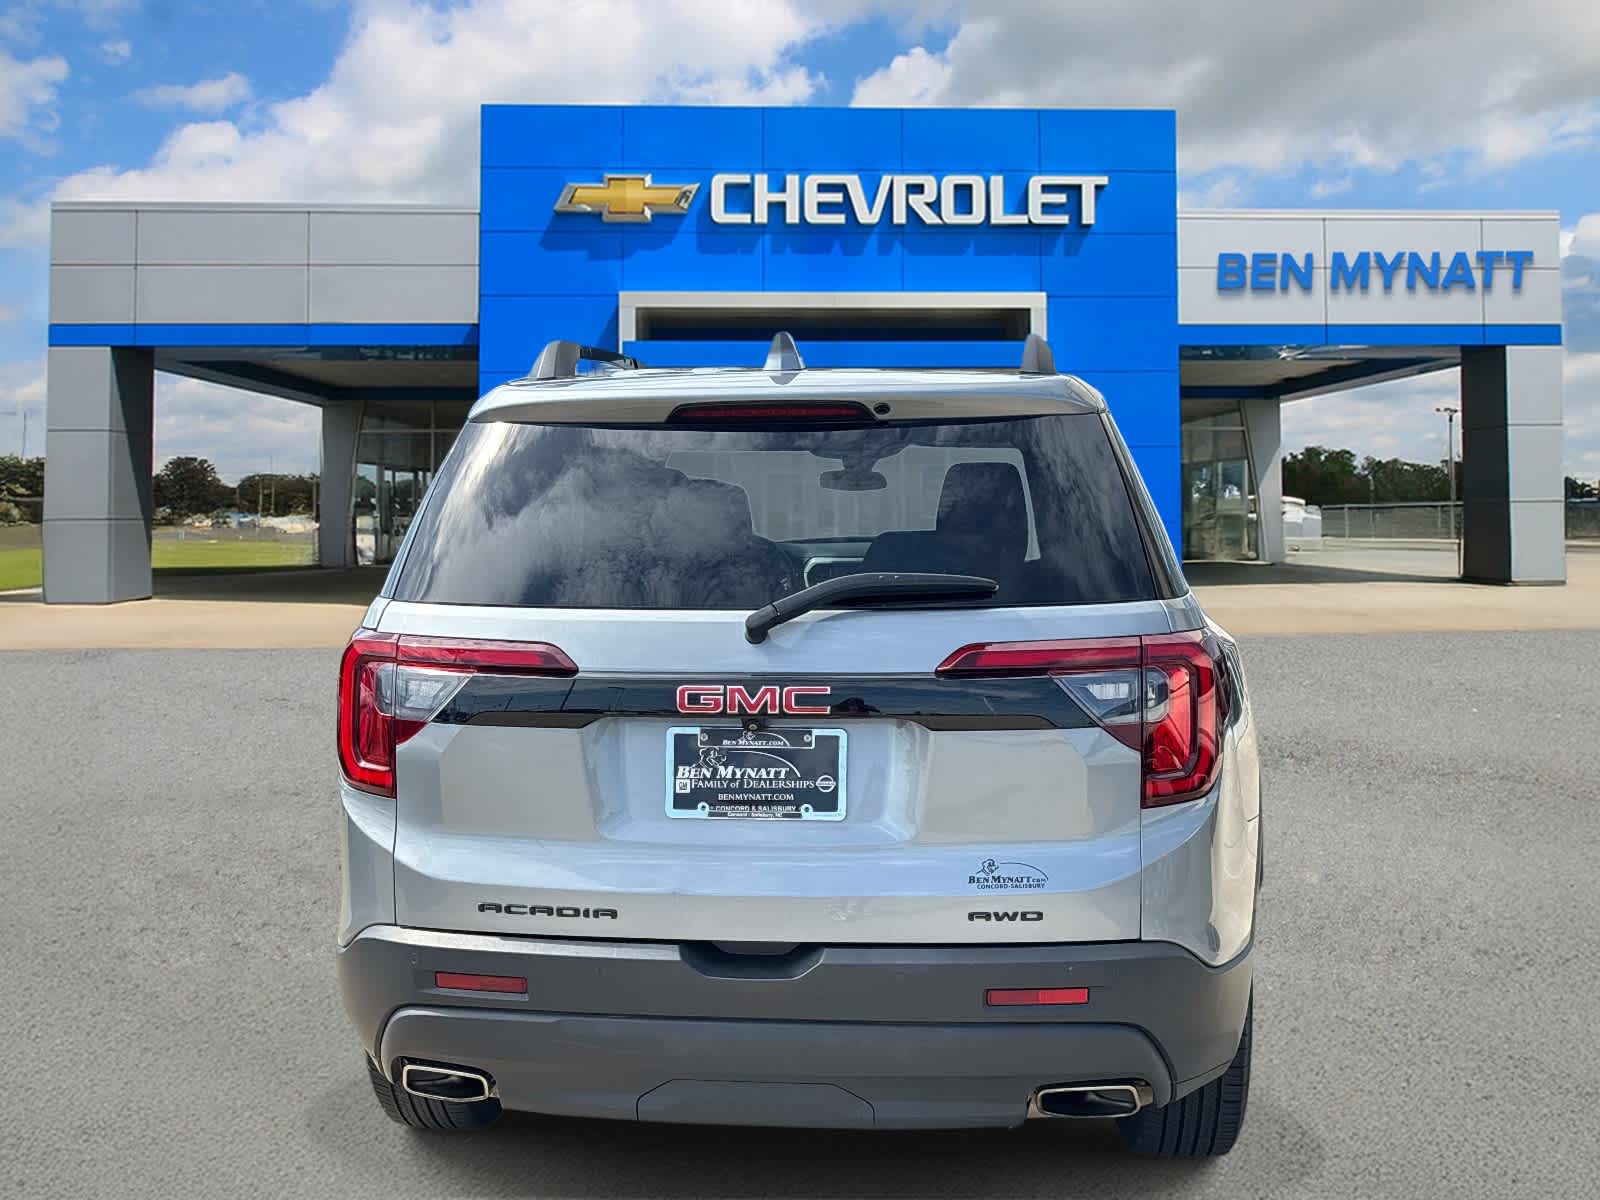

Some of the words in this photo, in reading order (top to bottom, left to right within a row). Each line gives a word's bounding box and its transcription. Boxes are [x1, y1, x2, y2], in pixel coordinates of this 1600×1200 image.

[710, 174, 1109, 225] CHEVROLET
[1217, 252, 1313, 291] BEN
[1330, 250, 1534, 290] MYNATT
[677, 685, 831, 714] GMC
[676, 766, 713, 779] BEN
[716, 766, 789, 779] MYNATT
[691, 779, 728, 789] FAMILY
[730, 780, 740, 788] of
[743, 779, 815, 789] DEALERSHIPS
[718, 793, 794, 801] BENMYNATT.COM
[968, 876, 990, 884] BEN
[477, 902, 618, 919] ACADIA
[968, 912, 1043, 921] AWD
